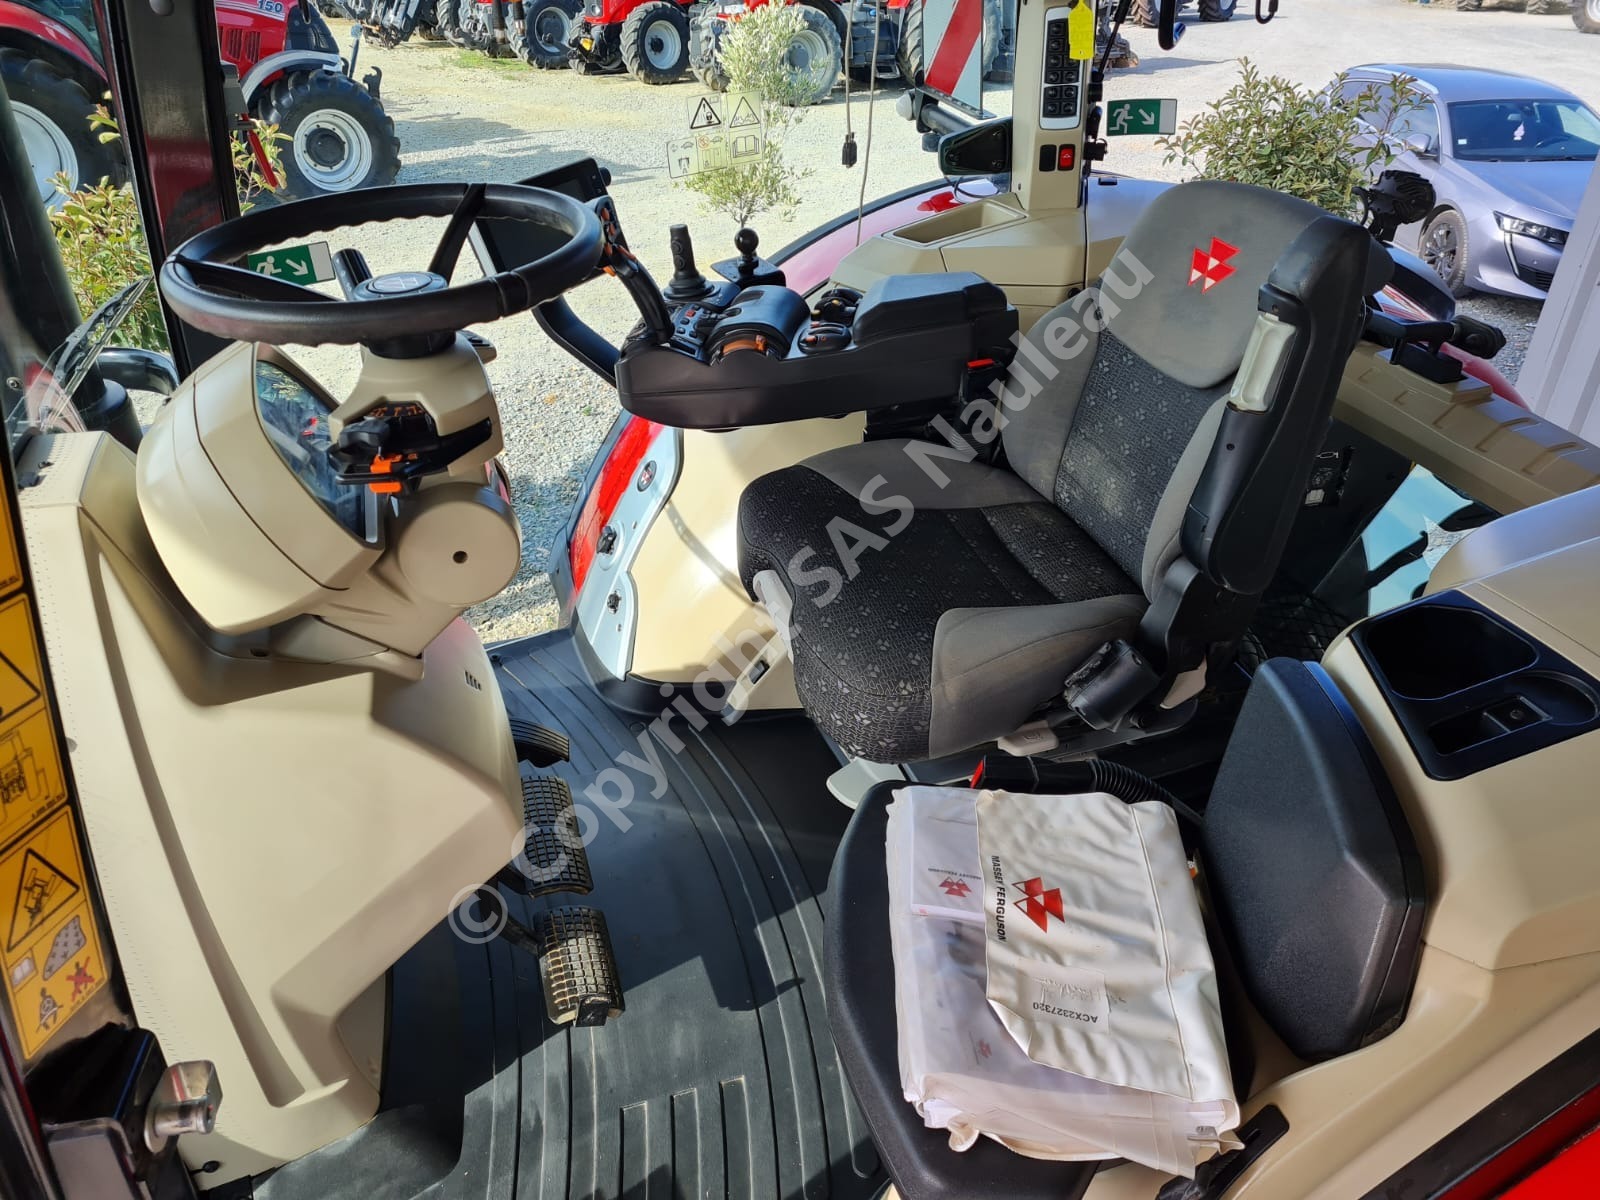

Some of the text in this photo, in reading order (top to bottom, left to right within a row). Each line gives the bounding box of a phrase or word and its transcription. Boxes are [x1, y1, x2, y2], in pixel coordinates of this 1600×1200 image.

[258, 0, 283, 12] 150
[991, 855, 1007, 943] MASSEY FERGUSON
[1032, 1001, 1098, 1023] ACX2327320
